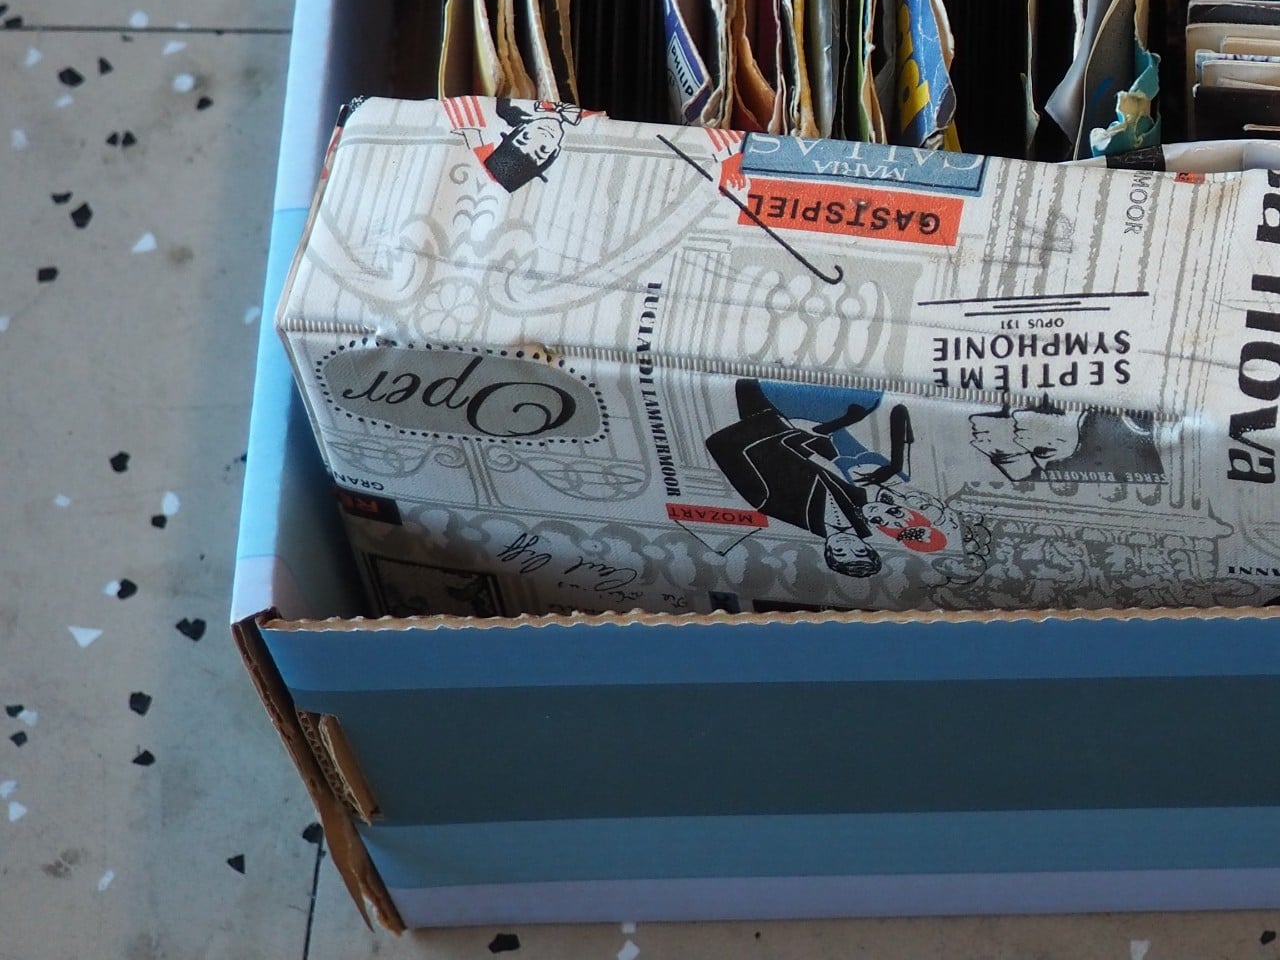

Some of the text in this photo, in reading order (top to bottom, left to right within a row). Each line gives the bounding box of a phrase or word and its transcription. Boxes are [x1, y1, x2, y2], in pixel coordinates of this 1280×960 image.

[811, 158, 909, 182] MARIA
[747, 193, 941, 236] GASTSPIEL
[1027, 316, 1065, 330] OPUS
[932, 329, 1132, 363] SYMPHONIE
[932, 358, 1132, 391] SEPTIEME
[341, 354, 577, 438] Oper
[640, 389, 682, 498] LAMMERMOOR
[1124, 472, 1169, 484] SERGE
[667, 505, 755, 525] MOZART
